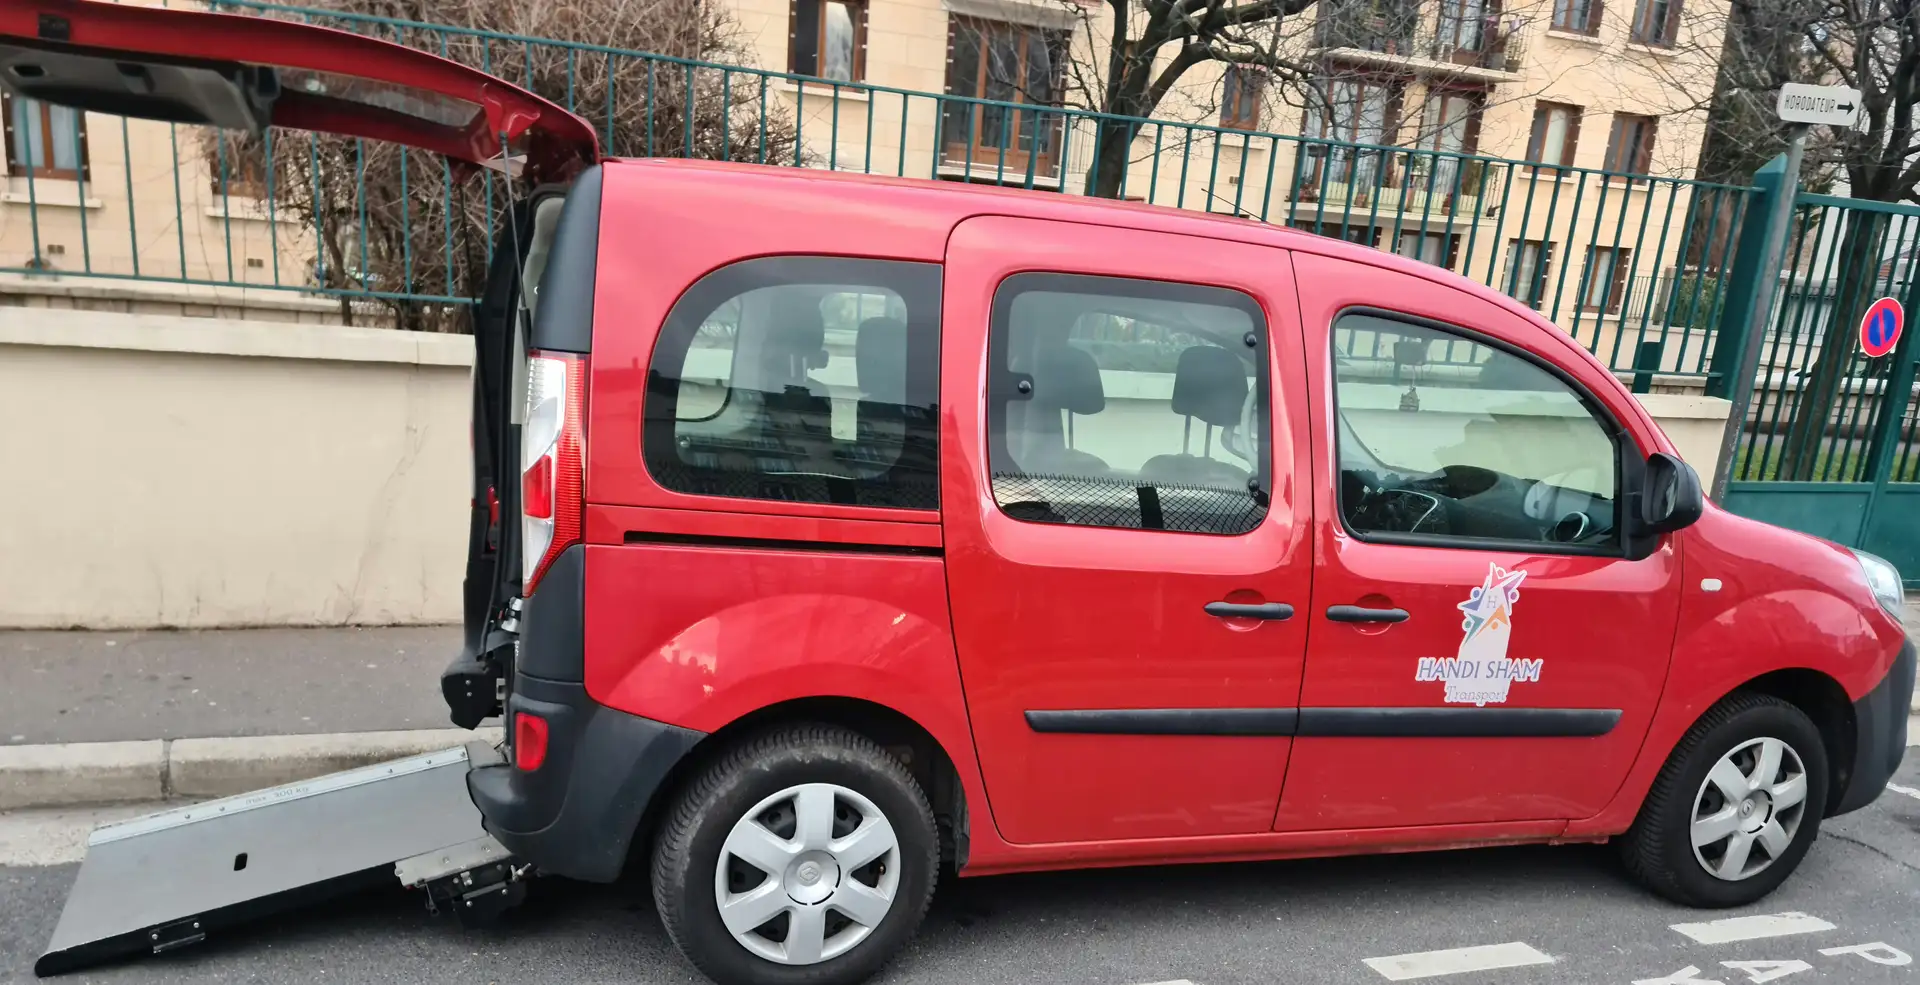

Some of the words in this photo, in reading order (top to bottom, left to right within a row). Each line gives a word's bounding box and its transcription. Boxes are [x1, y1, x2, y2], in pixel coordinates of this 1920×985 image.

[1784, 94, 1836, 113] HORODATEUR
[1418, 659, 1482, 679] HANDI
[1485, 660, 1541, 680] SHAM
[1446, 685, 1506, 705] Transport
